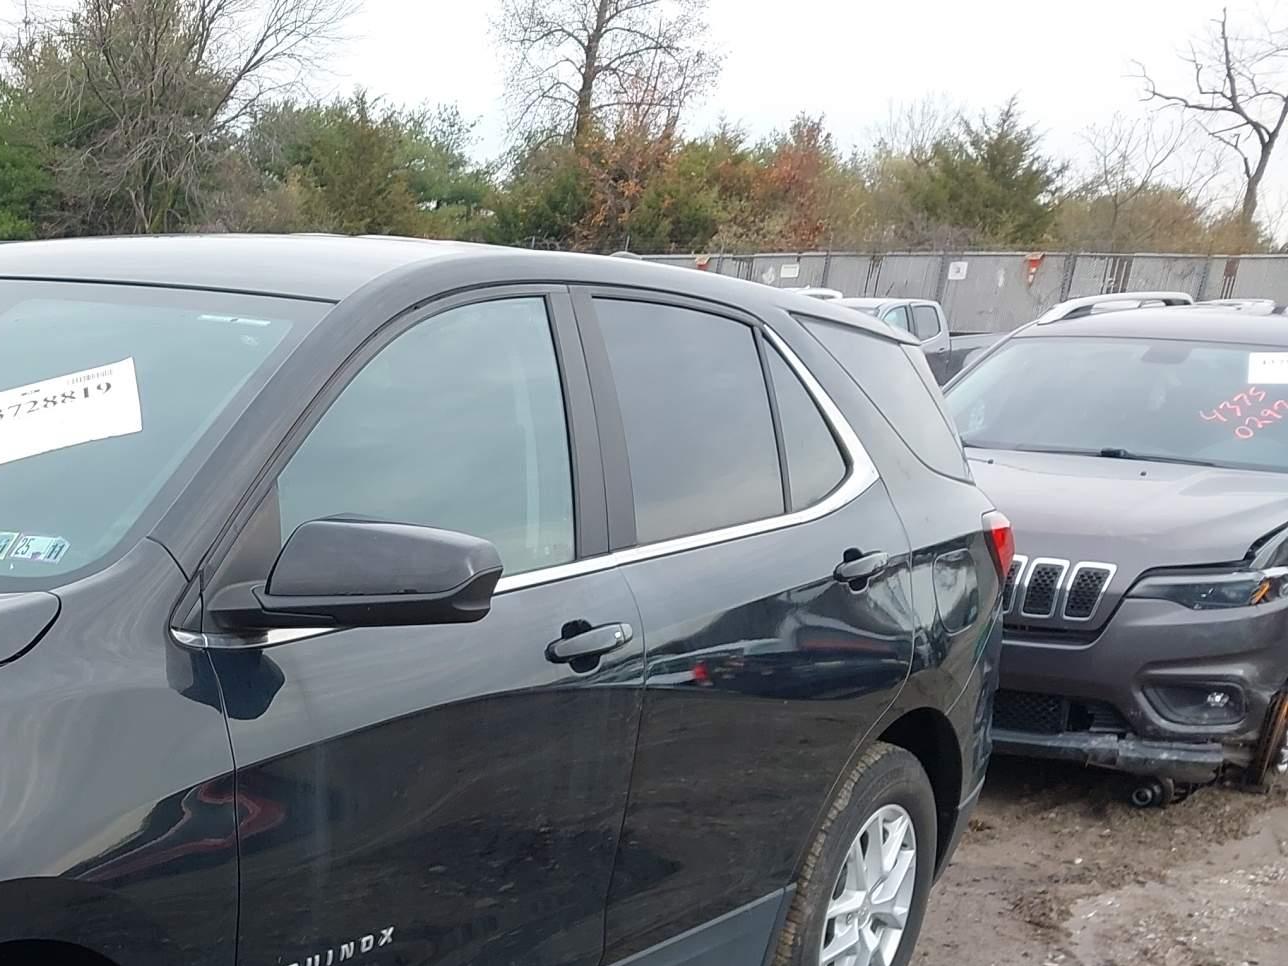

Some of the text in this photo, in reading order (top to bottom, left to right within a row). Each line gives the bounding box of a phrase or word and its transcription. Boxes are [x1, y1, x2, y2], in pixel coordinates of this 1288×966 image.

[1199, 386, 1266, 422] 4375
[14, 538, 66, 560] 25 11
